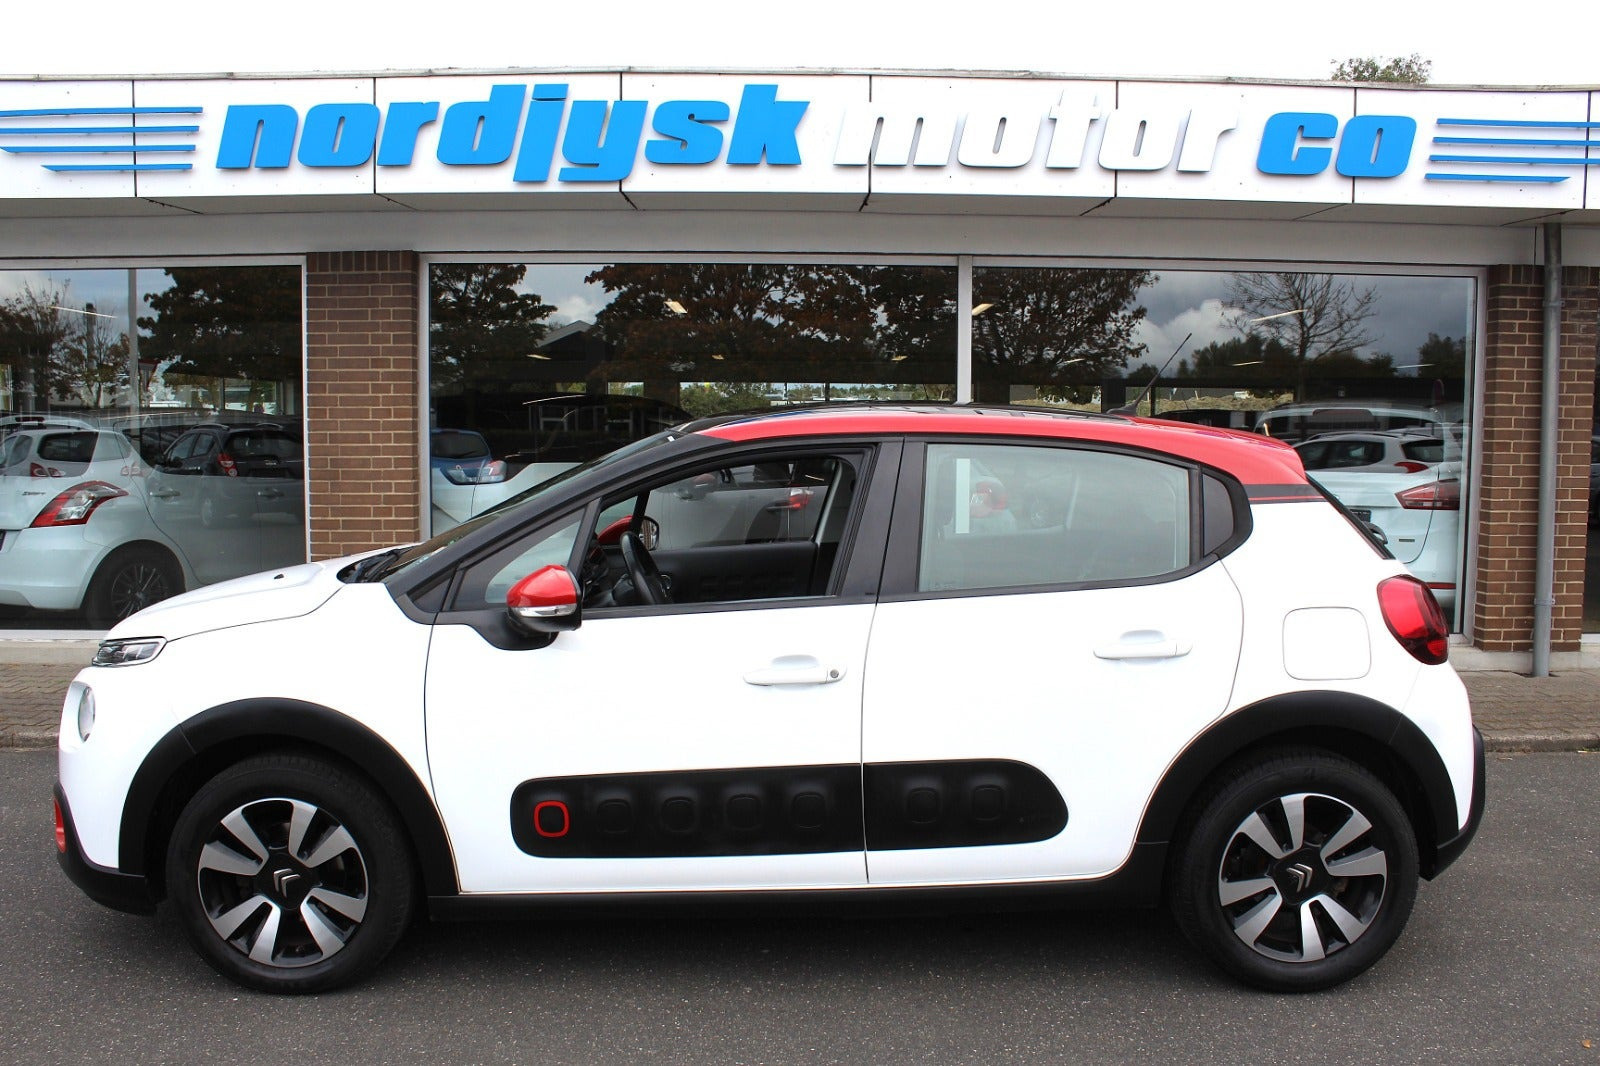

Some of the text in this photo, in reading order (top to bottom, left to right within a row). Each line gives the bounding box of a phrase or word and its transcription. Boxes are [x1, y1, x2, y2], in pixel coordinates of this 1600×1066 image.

[215, 83, 1416, 183] nordjysk motor co
